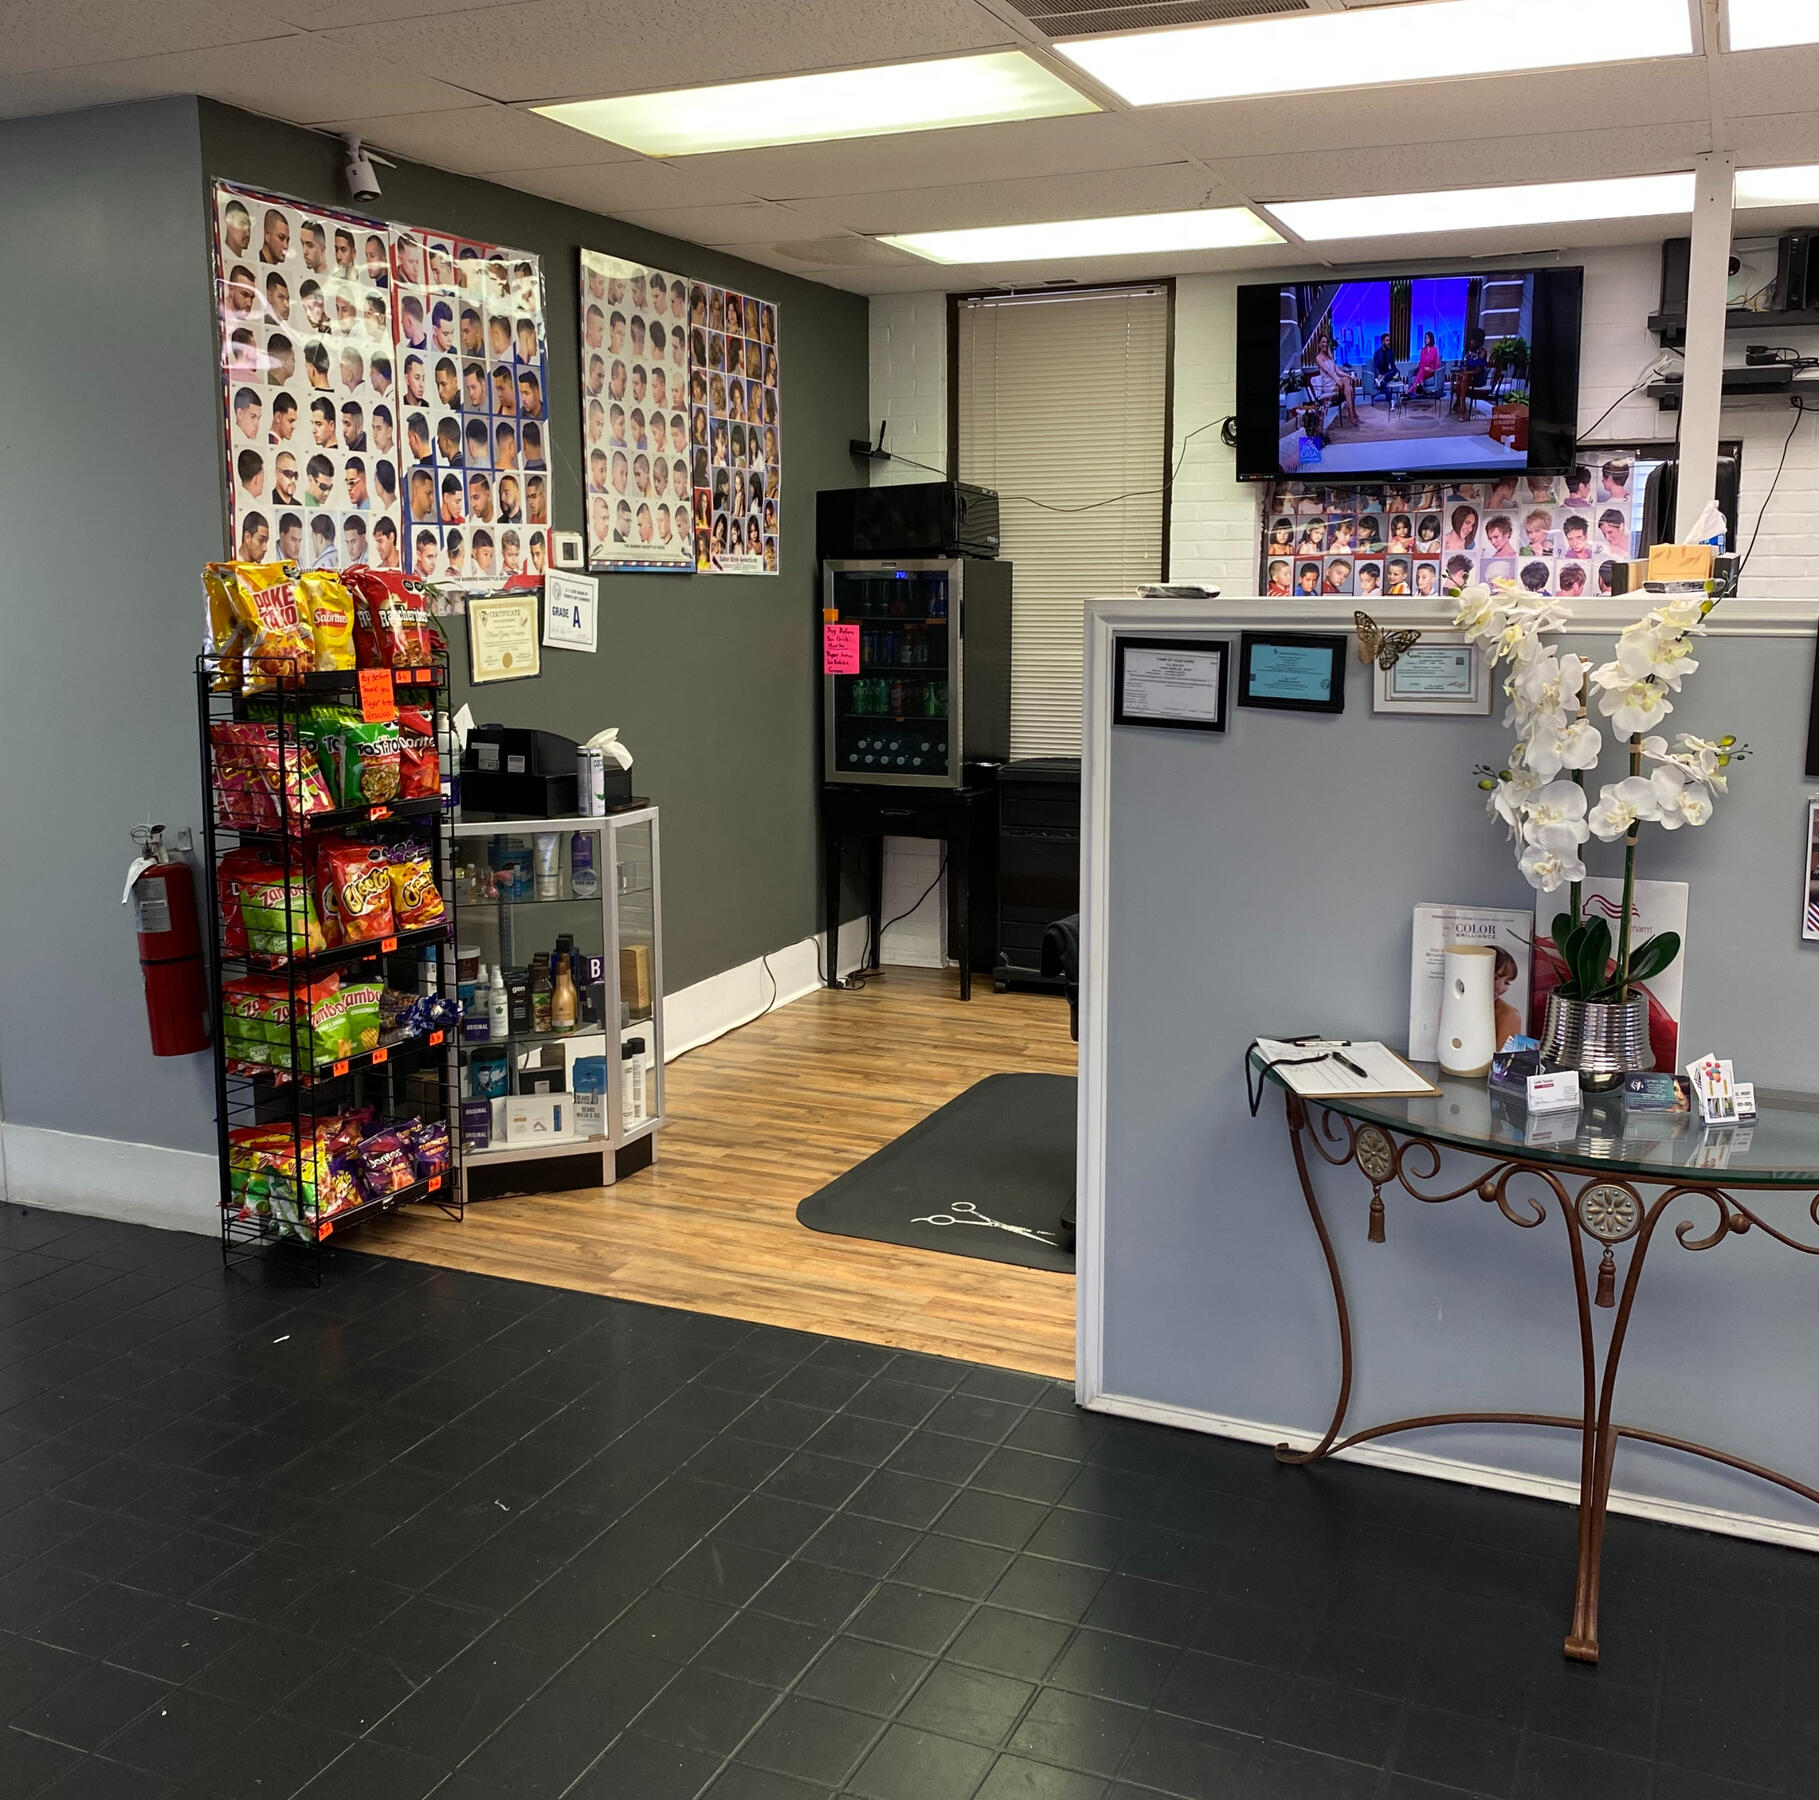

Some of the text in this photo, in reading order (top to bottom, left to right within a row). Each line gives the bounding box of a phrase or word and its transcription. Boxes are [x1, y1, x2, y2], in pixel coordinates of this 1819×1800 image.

[1301, 450, 1318, 458] CASA
[314, 610, 348, 624] Sabritas
[552, 605, 582, 629] GRADE A
[1455, 923, 1496, 935] COLOR
[466, 1023, 489, 1031] ORIGINAL
[465, 1107, 488, 1115] ORIGINAL
[465, 1131, 488, 1139] ORIGINAL
[368, 1148, 403, 1169] Doritos
